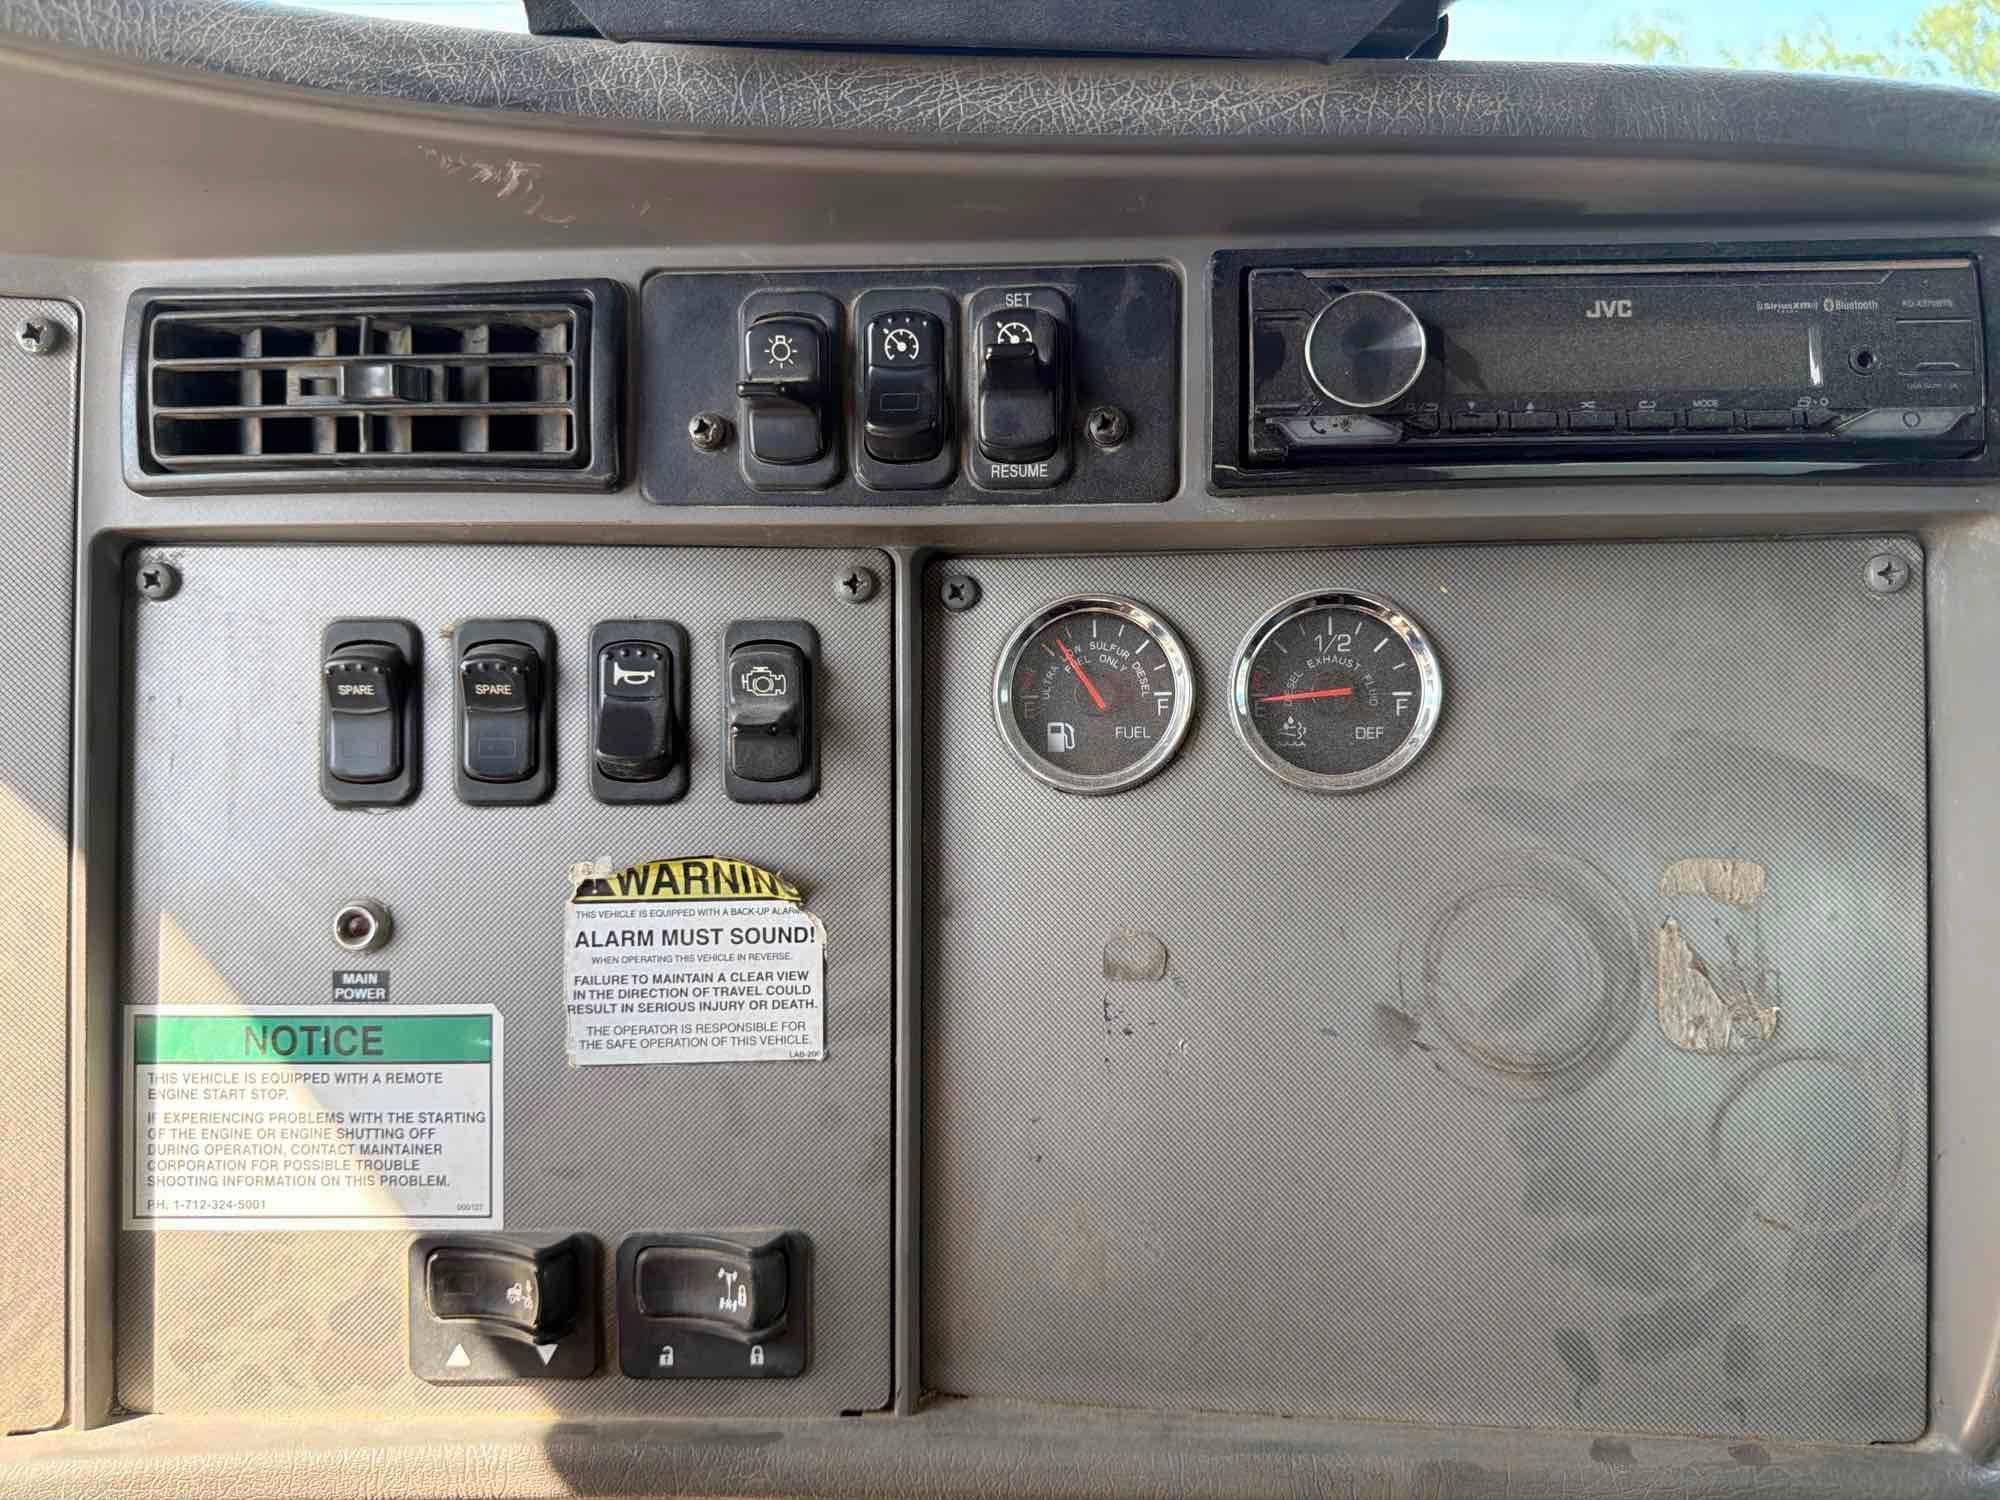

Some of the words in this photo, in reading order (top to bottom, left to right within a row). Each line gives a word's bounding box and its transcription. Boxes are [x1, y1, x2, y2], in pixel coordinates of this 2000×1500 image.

[1005, 293, 1032, 306] SET
[1835, 299, 1878, 310] Bluetooth
[1585, 300, 1633, 318] JVC
[1692, 399, 1719, 408] MODE
[991, 464, 1048, 478] RESUME
[1314, 634, 1351, 653] 1/2
[1089, 641, 1130, 660] SULFUR
[1132, 661, 1150, 697] DIESEL
[1099, 654, 1128, 672] ONLY
[1306, 655, 1361, 671] EXHAUST
[337, 684, 375, 696] SPARE
[475, 684, 513, 696] SPARE
[1157, 698, 1169, 716] F
[1396, 698, 1408, 716] F
[1115, 726, 1151, 739] FUEL
[1355, 726, 1384, 740] DEF
[616, 861, 800, 896] WARNIN
[576, 910, 597, 919] THIS
[600, 910, 636, 919] VEHICLE
[639, 910, 647, 918] IS
[650, 909, 695, 918] EQUIPPED
[696, 907, 720, 916] WITH
[722, 907, 729, 916] A
[575, 929, 654, 948] ALARM
[662, 927, 723, 946] MUST
[730, 926, 815, 945] SOUND!
[591, 956, 619, 965] WHEN
[621, 955, 673, 964] OPERATING
[675, 954, 695, 963] THIS
[697, 953, 735, 962] VEHICLE
[737, 953, 746, 961] IN
[343, 973, 378, 984] MAIN
[574, 975, 629, 986] FAILURE
[631, 974, 649, 985] TO
[652, 973, 713, 984] MAINTAIN
[717, 972, 726, 982] A
[730, 971, 774, 982] CLEAR
[776, 970, 809, 981] VIEW
[335, 987, 386, 1000] POWER
[573, 990, 586, 1000] IN
[589, 989, 614, 1000] THE
[618, 987, 689, 999] DIRECTION
[692, 987, 710, 998] OF
[711, 986, 762, 997] TRAVEL
[766, 984, 811, 996] COULD
[567, 1003, 618, 1015] RESULT
[621, 1003, 634, 1013] IN
[637, 1002, 696, 1013] SERIOUS
[699, 1000, 745, 1012] INJURY
[749, 1000, 768, 1010] OR
[772, 999, 818, 1010] DEATH.
[586, 1025, 610, 1036] THE
[613, 1024, 678, 1036] OPERATOR
[681, 1023, 693, 1034] IS
[695, 1022, 779, 1033] RESPONSIBLE
[782, 1021, 806, 1032] FOR
[244, 1025, 384, 1057] NOTICE
[579, 1039, 605, 1050] THE
[606, 1038, 637, 1050] SAFE
[640, 1037, 708, 1049] OPERATION
[711, 1037, 728, 1047] OF
[730, 1035, 758, 1047] THIS
[148, 1072, 178, 1084] THIS
[182, 1072, 240, 1084] VEHICLE
[244, 1072, 258, 1084] IS
[262, 1072, 330, 1084] EQUIPPED
[334, 1072, 368, 1084] WITH
[372, 1072, 382, 1084] A
[386, 1072, 444, 1084] REMOTE
[148, 1088, 198, 1100] ENGINE
[202, 1088, 246, 1100] START
[250, 1088, 288, 1100] STOP.
[148, 1112, 156, 1124] IF
[164, 1112, 264, 1124] EXPERIENCING
[268, 1112, 344, 1124] PROBLEMS
[348, 1112, 384, 1124] WITH
[388, 1112, 414, 1124] THE
[418, 1112, 486, 1124] STARTING
[148, 1128, 166, 1139] OF
[170, 1128, 196, 1139] THE
[202, 1128, 252, 1139] ENGINE
[256, 1128, 276, 1139] OR
[280, 1128, 332, 1139] ENGINE
[336, 1128, 404, 1139] SHUTTING
[408, 1128, 436, 1139] OFF
[148, 1144, 200, 1155] DURING
[204, 1144, 288, 1155] OPERATION,
[290, 1144, 356, 1155] CONTACT
[360, 1144, 442, 1155] MAINTAINER
[146, 1160, 246, 1171] CORPORATION
[250, 1160, 278, 1171] FOR
[284, 1160, 350, 1171] POSSIBLE
[356, 1160, 420, 1171] TROUBLE
[146, 1175, 218, 1187] SHOOTING
[222, 1175, 316, 1187] INFORMATION
[320, 1175, 340, 1187] ON
[344, 1175, 376, 1187] THIS
[380, 1175, 450, 1187] PROBLEM.
